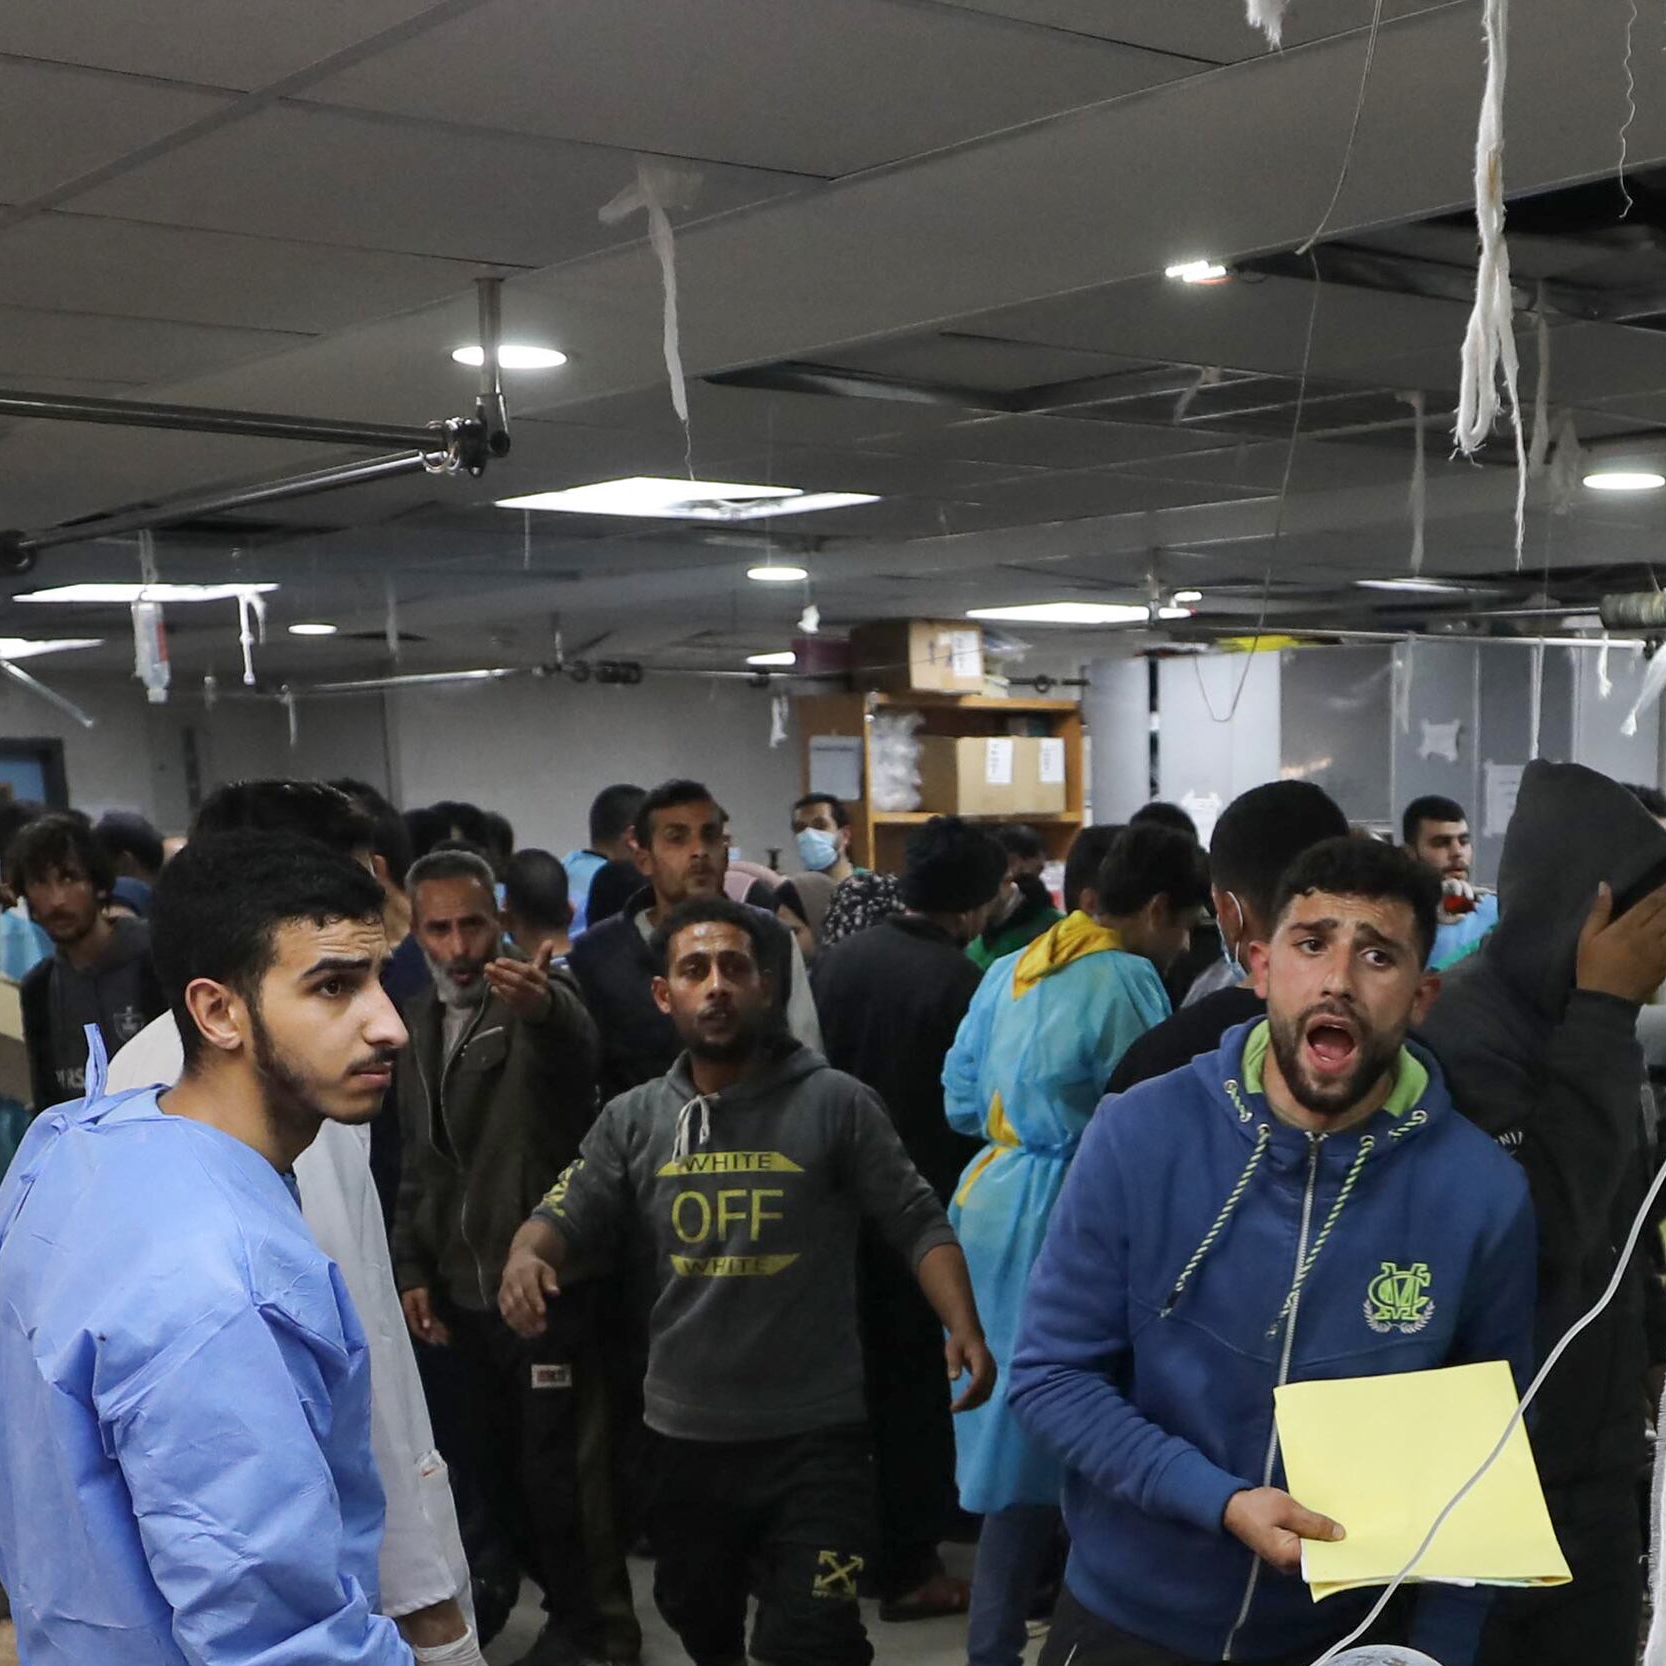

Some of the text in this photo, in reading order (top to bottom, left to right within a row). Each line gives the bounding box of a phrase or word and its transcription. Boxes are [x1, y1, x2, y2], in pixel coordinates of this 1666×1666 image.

[684, 1152, 773, 1172] WHITE
[671, 1188, 784, 1244] OFF
[683, 1256, 768, 1274] WHITE
